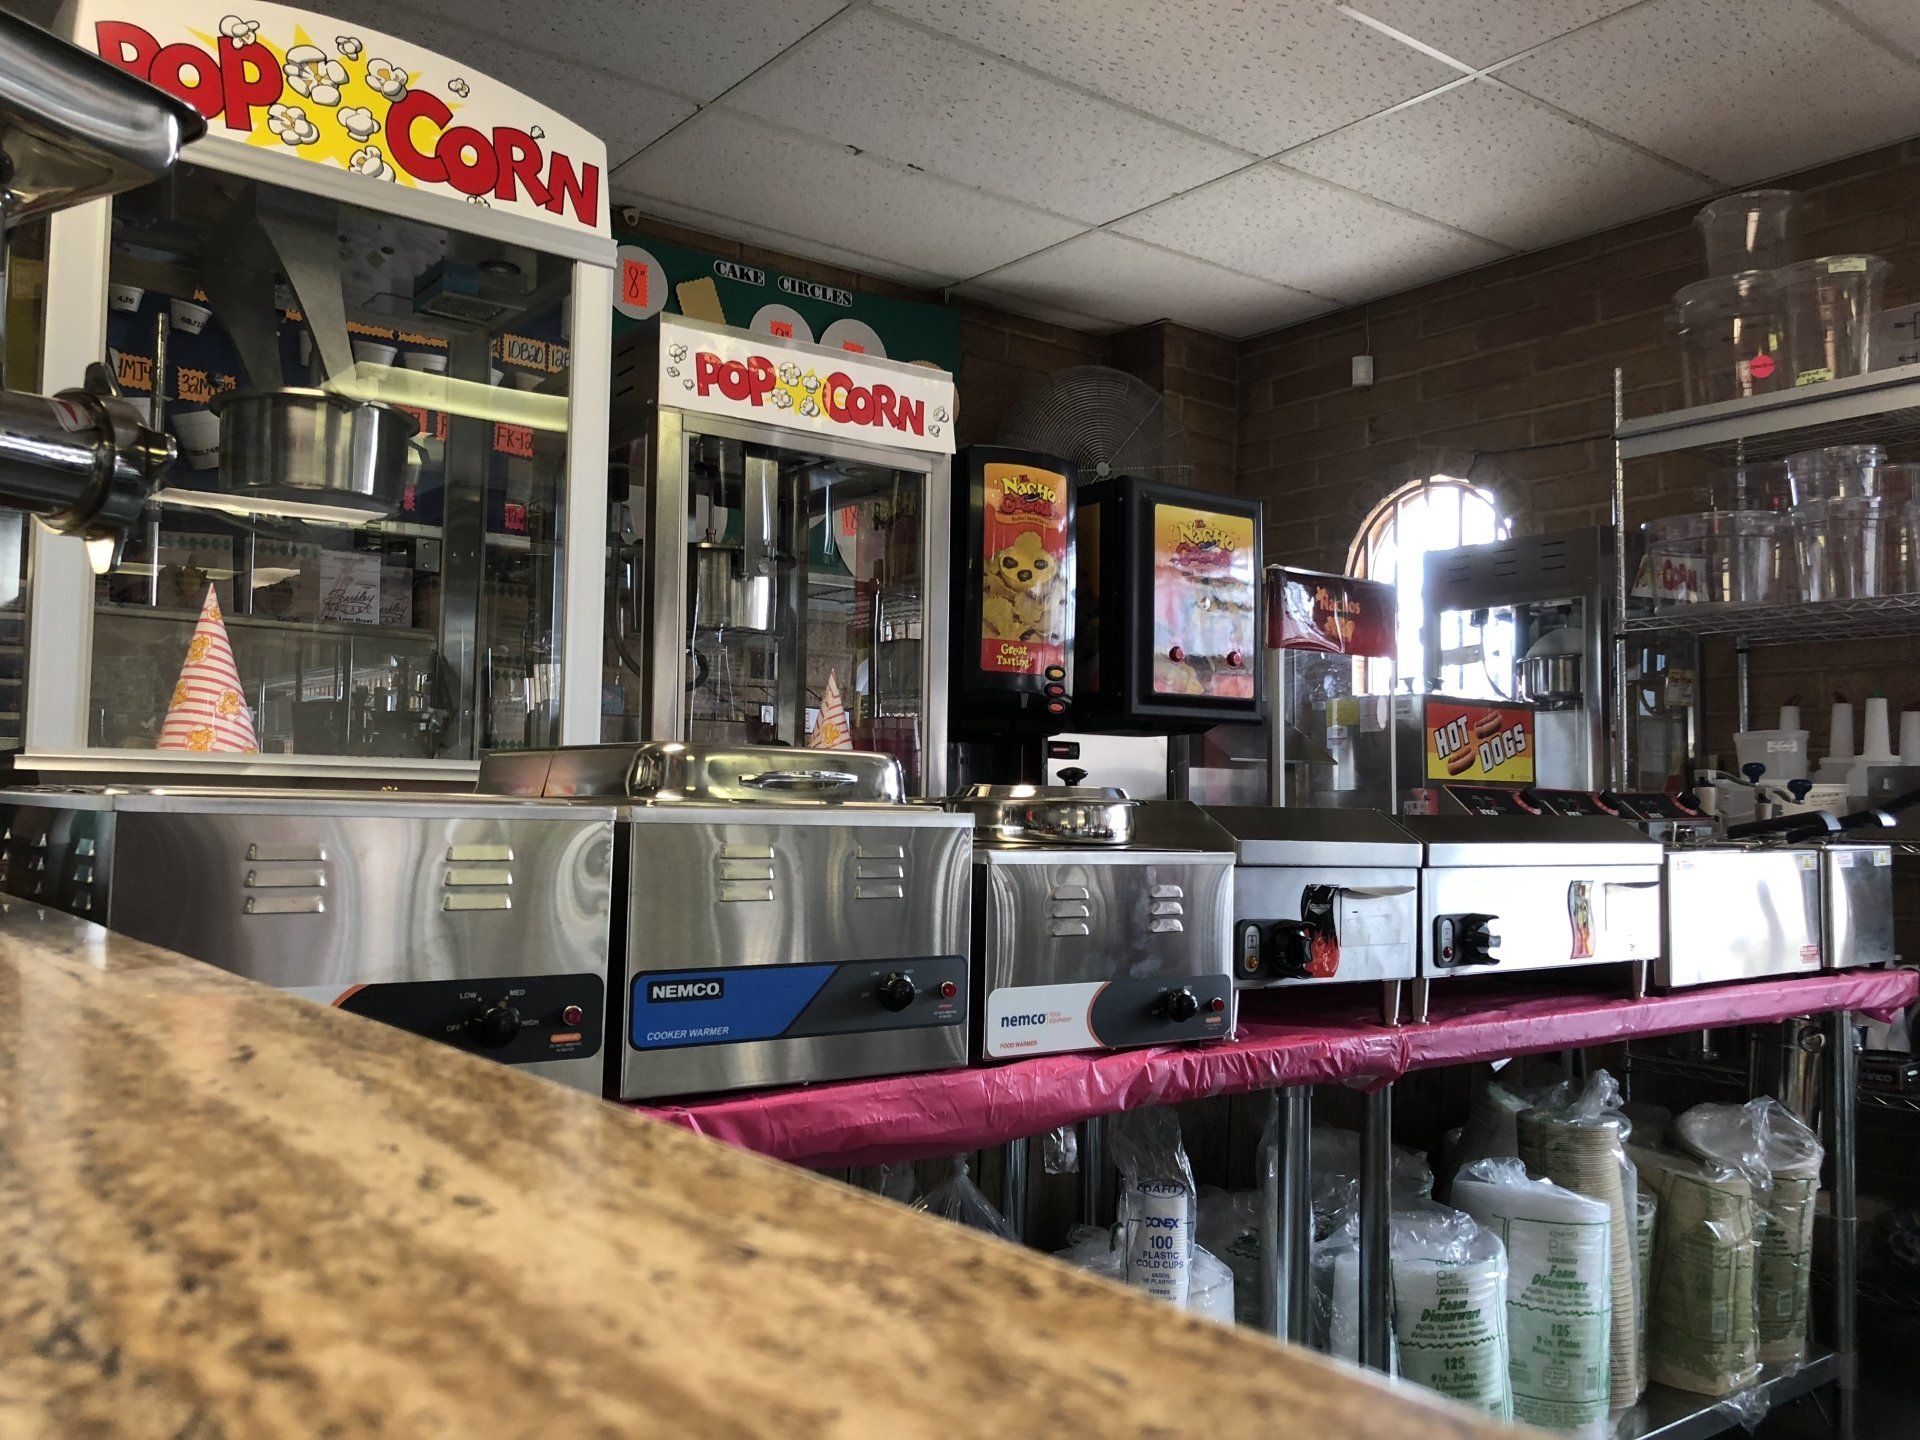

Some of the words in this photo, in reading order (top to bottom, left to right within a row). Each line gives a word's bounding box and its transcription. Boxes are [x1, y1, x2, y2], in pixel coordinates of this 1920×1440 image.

[385, 89, 599, 227] CORN
[714, 261, 764, 284] CAKE
[778, 276, 852, 306] CIRCLES
[695, 352, 777, 406] POP
[823, 371, 925, 436] CORN
[496, 426, 532, 450] FK-12
[1001, 644, 1028, 655] Great
[996, 655, 1033, 669] Tasting!
[1434, 715, 1469, 760] HOT
[1478, 722, 1527, 773] DOGS
[460, 992, 478, 1000] LOW
[509, 989, 526, 997] MED
[652, 982, 721, 999] NEMCO
[521, 1019, 540, 1027] HIGH
[1001, 1013, 1046, 1028] nemco
[446, 1024, 461, 1032] OFF
[646, 1029, 688, 1041] COOKER
[689, 1026, 730, 1038] WARMER
[1015, 1040, 1038, 1048] WARMER
[1150, 1235, 1174, 1250] 100
[1142, 1250, 1180, 1260] PLASTIC
[1136, 1259, 1161, 1269] COLD
[1162, 1260, 1185, 1269] CUPS
[1438, 1298, 1468, 1310] Foam
[1420, 1308, 1481, 1322] Dinnerware
[1551, 1323, 1571, 1337] 125
[1444, 1356, 1466, 1370] 125
[1431, 1374, 1437, 1383] 9
